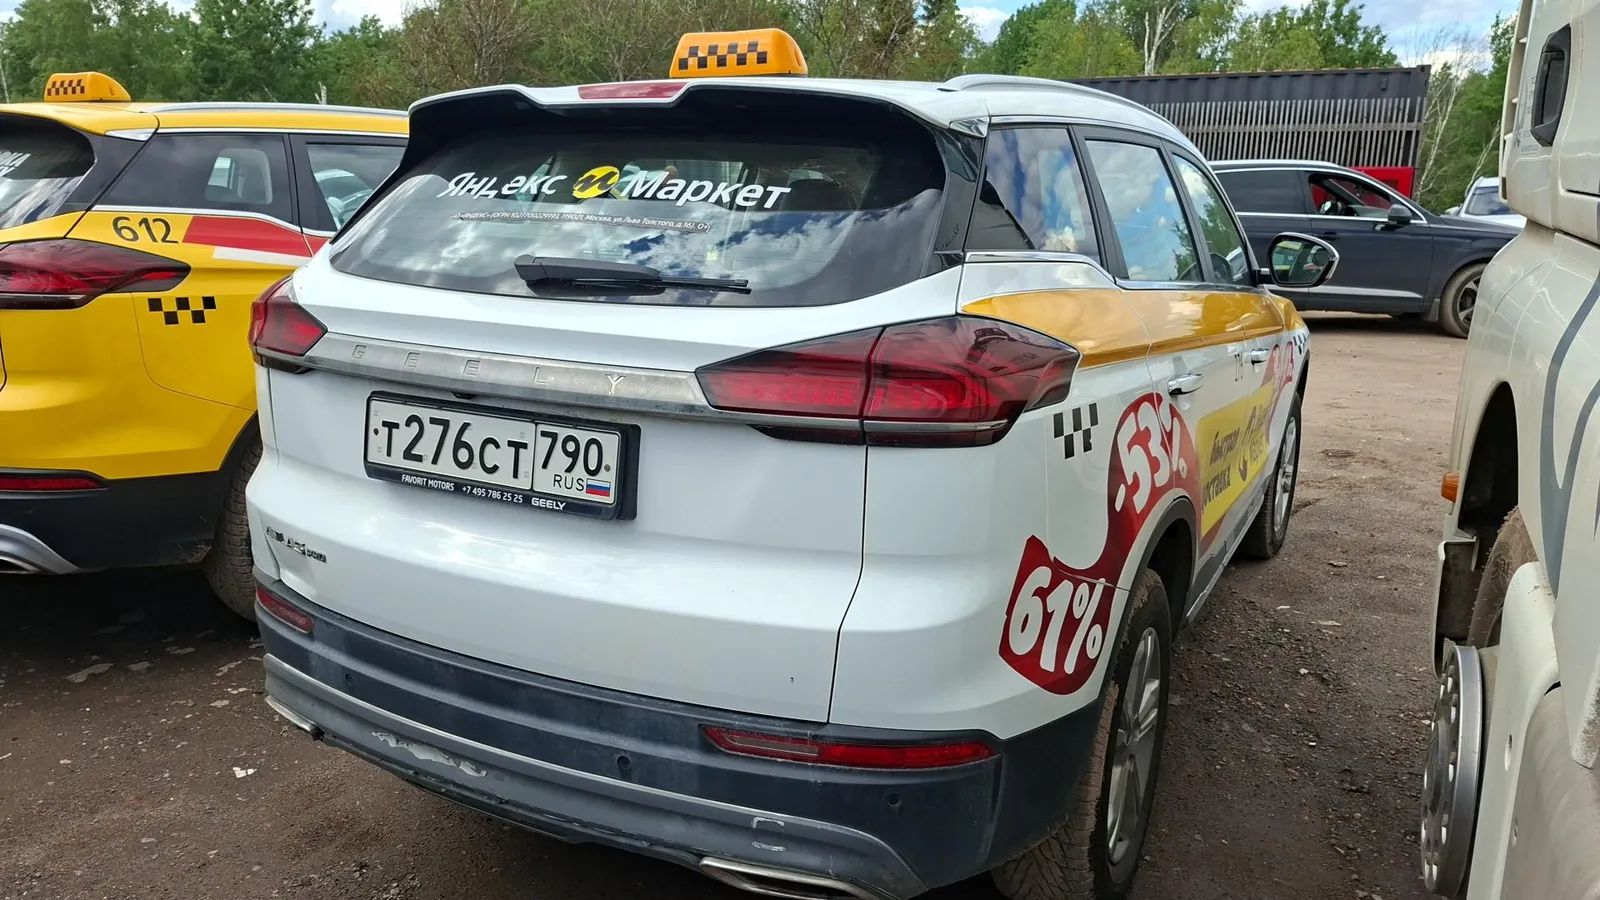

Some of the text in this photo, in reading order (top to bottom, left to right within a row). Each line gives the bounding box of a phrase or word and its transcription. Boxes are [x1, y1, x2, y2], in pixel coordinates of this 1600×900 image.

[436, 169, 792, 209] Яндекс Маркет
[112, 216, 179, 244] 612
[351, 344, 626, 396] GEELY
[540, 430, 603, 477] 790
[401, 474, 566, 511] FAVORIT MOTORS +7 495 786 25 25 GEELY
[553, 474, 584, 492] RUS
[1008, 565, 1106, 675] 61%
